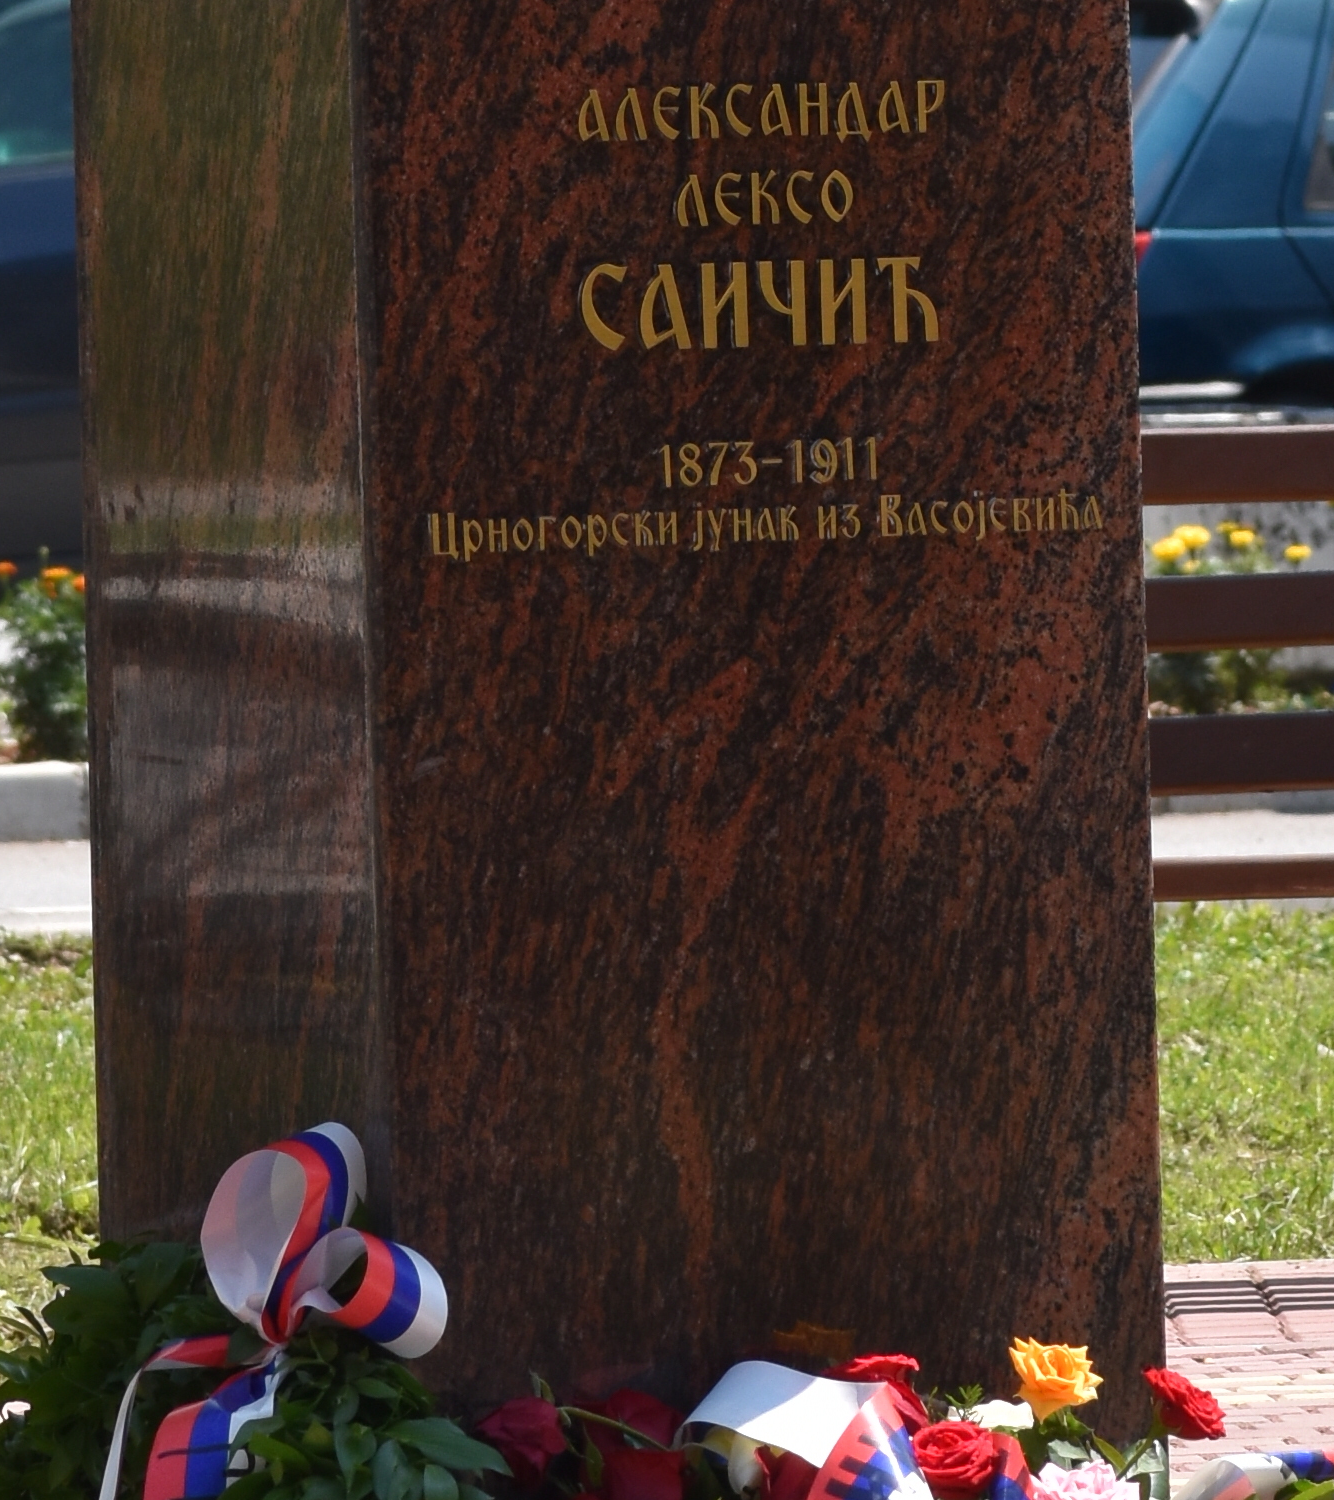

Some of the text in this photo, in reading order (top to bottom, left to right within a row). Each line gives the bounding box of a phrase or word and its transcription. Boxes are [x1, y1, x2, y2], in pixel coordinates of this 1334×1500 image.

[579, 79, 946, 143] АЛЕКСАНДАР
[676, 169, 855, 228] ЛЕКСО
[579, 256, 940, 351] САИЧИЋ
[430, 488, 1104, 562] Црногорски јунак из Васојевића
